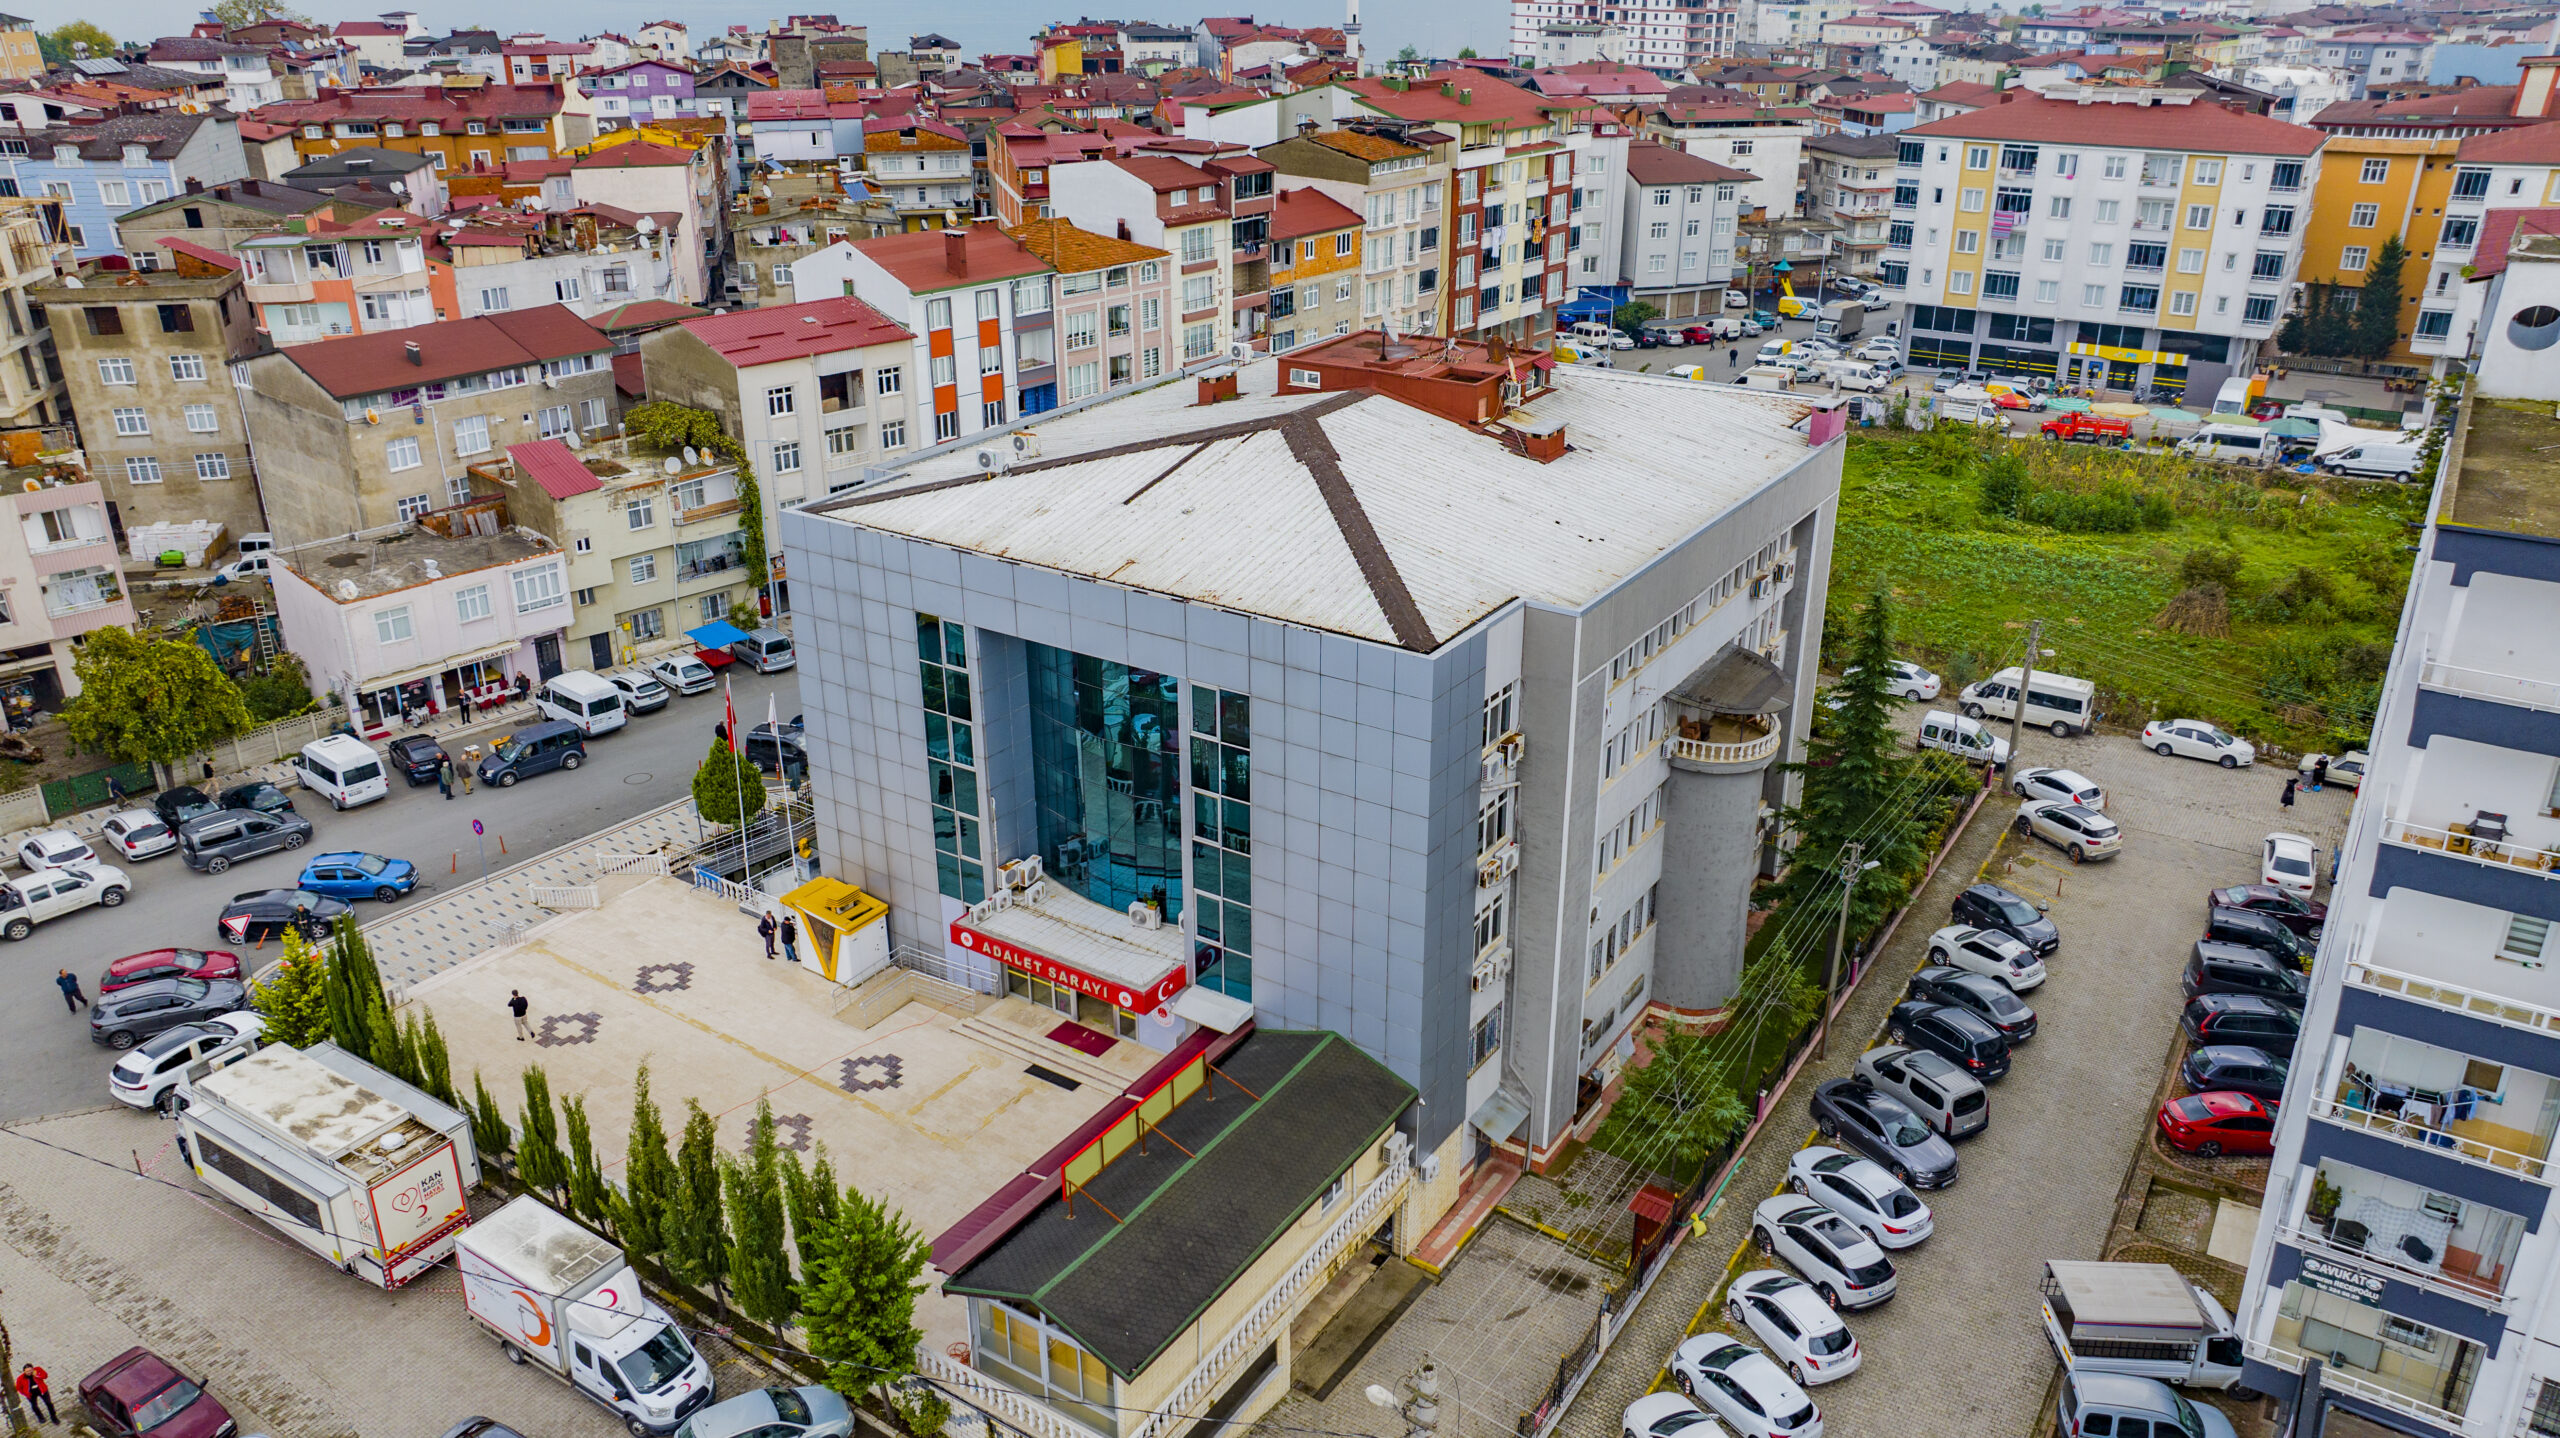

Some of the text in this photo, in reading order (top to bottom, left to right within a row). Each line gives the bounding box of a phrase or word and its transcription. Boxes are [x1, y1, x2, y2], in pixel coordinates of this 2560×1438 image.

[982, 941, 1108, 999] ADALET SARAYI
[421, 1170, 442, 1187] KAN
[2318, 1263, 2368, 1286] AVUKAT
[2333, 1280, 2379, 1300] RECEPOĞLU
